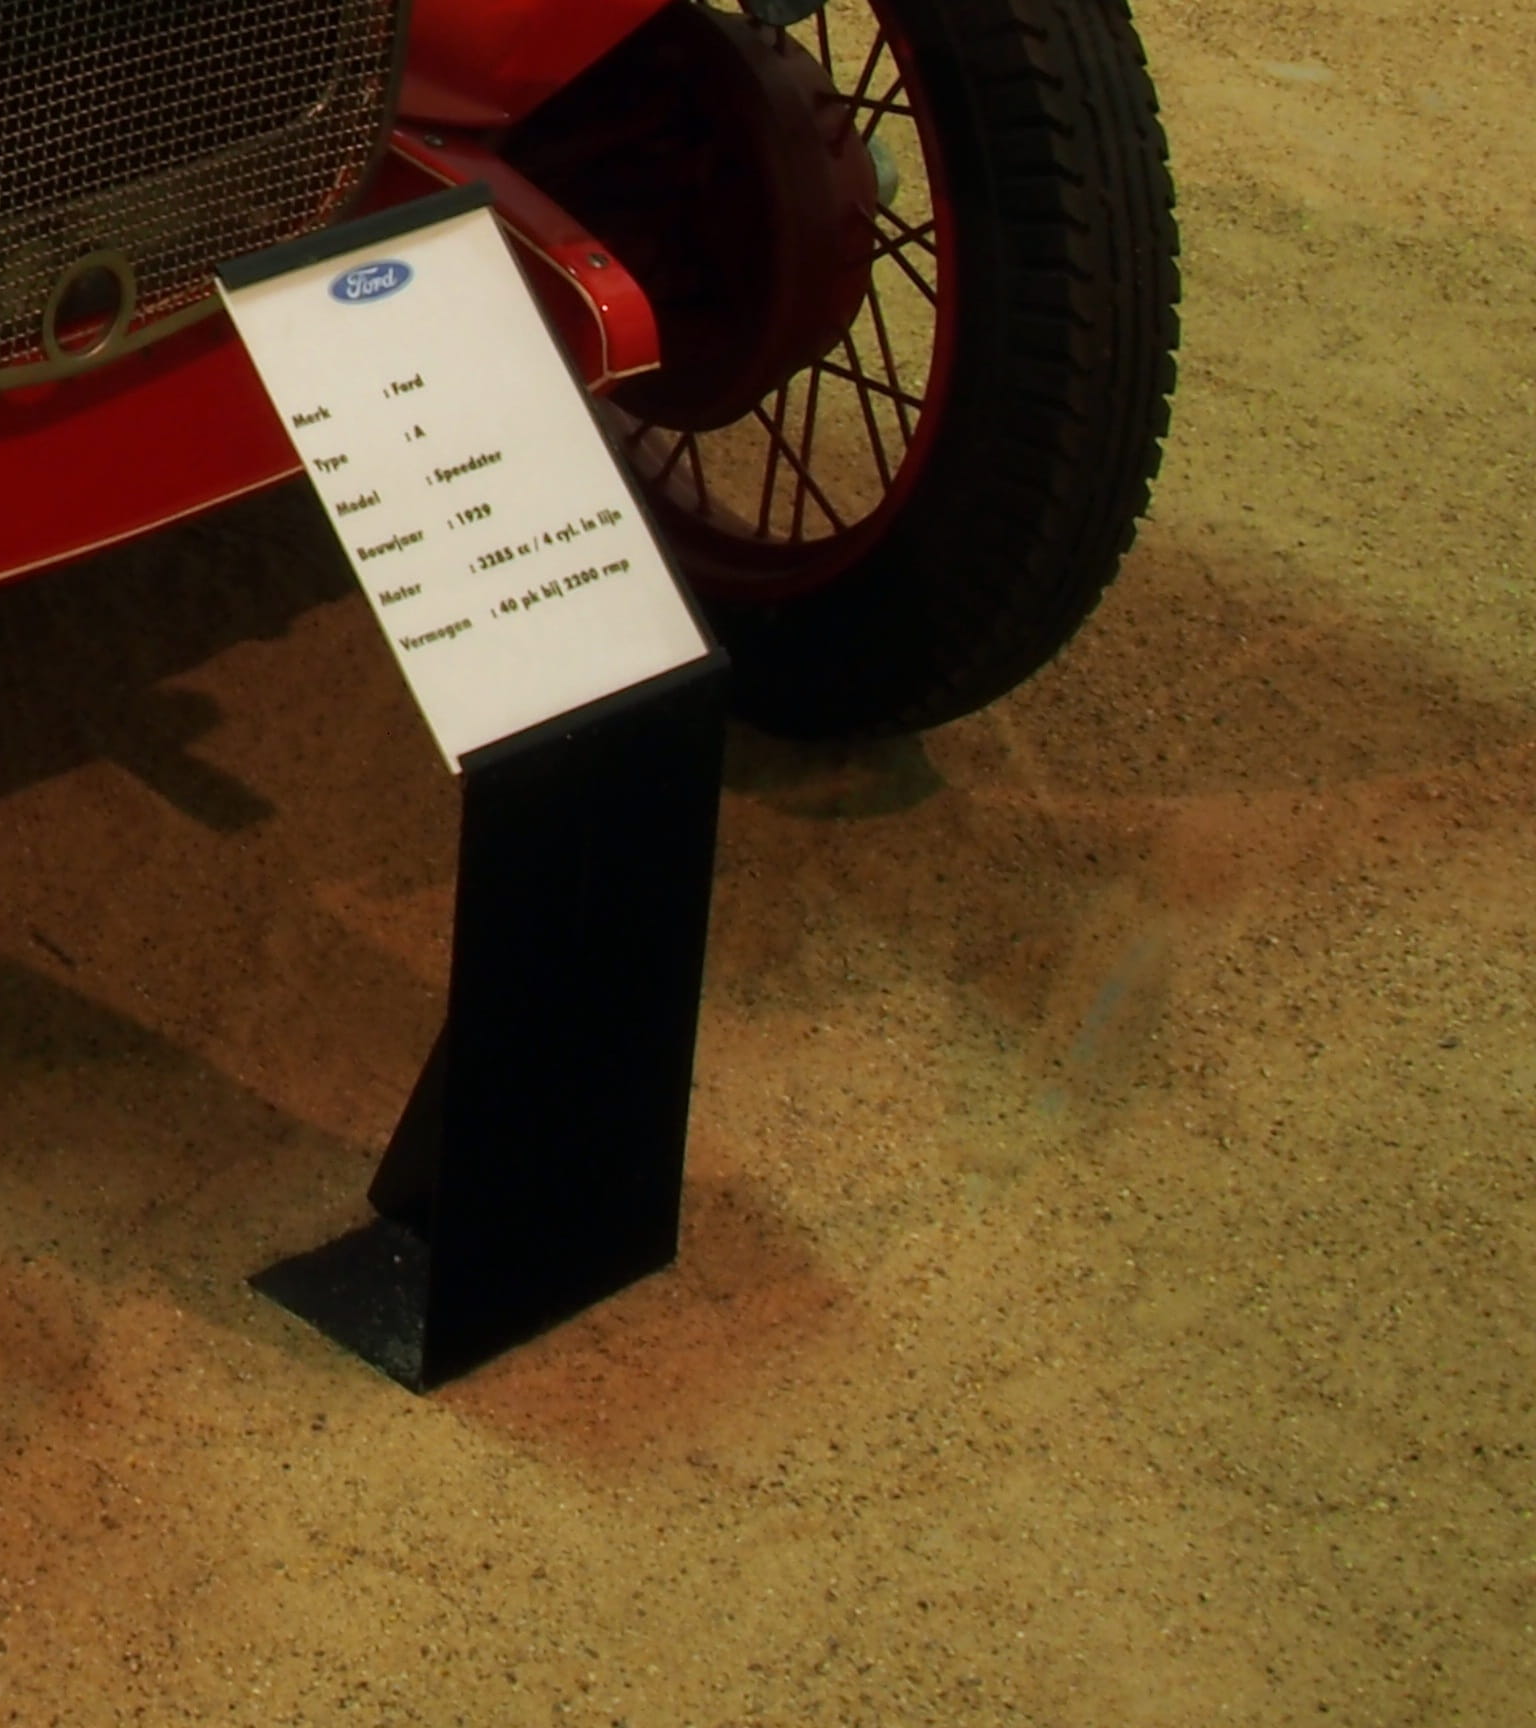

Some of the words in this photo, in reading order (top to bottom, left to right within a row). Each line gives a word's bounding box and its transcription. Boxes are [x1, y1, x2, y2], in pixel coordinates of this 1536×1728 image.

[345, 266, 398, 300] Ford
[292, 405, 331, 429] Merk
[391, 373, 424, 395] Ford
[313, 453, 348, 474] Type
[414, 424, 426, 439] A
[336, 490, 381, 517] Model
[434, 451, 501, 483] Speedster
[356, 530, 424, 562] Bouwjaar
[456, 502, 492, 526] 1929
[379, 583, 422, 607] Motor
[477, 546, 514, 571] 3285
[517, 543, 531, 556] cc
[543, 532, 553, 546] 4
[556, 523, 580, 543] cyl.
[580, 518, 596, 532] in
[597, 509, 622, 527] lijn
[399, 618, 472, 652] Vermogen
[500, 598, 518, 615] 40
[521, 589, 540, 611] pk
[540, 580, 564, 598] bij
[563, 567, 599, 591] 2200
[601, 558, 630, 576] rmp
